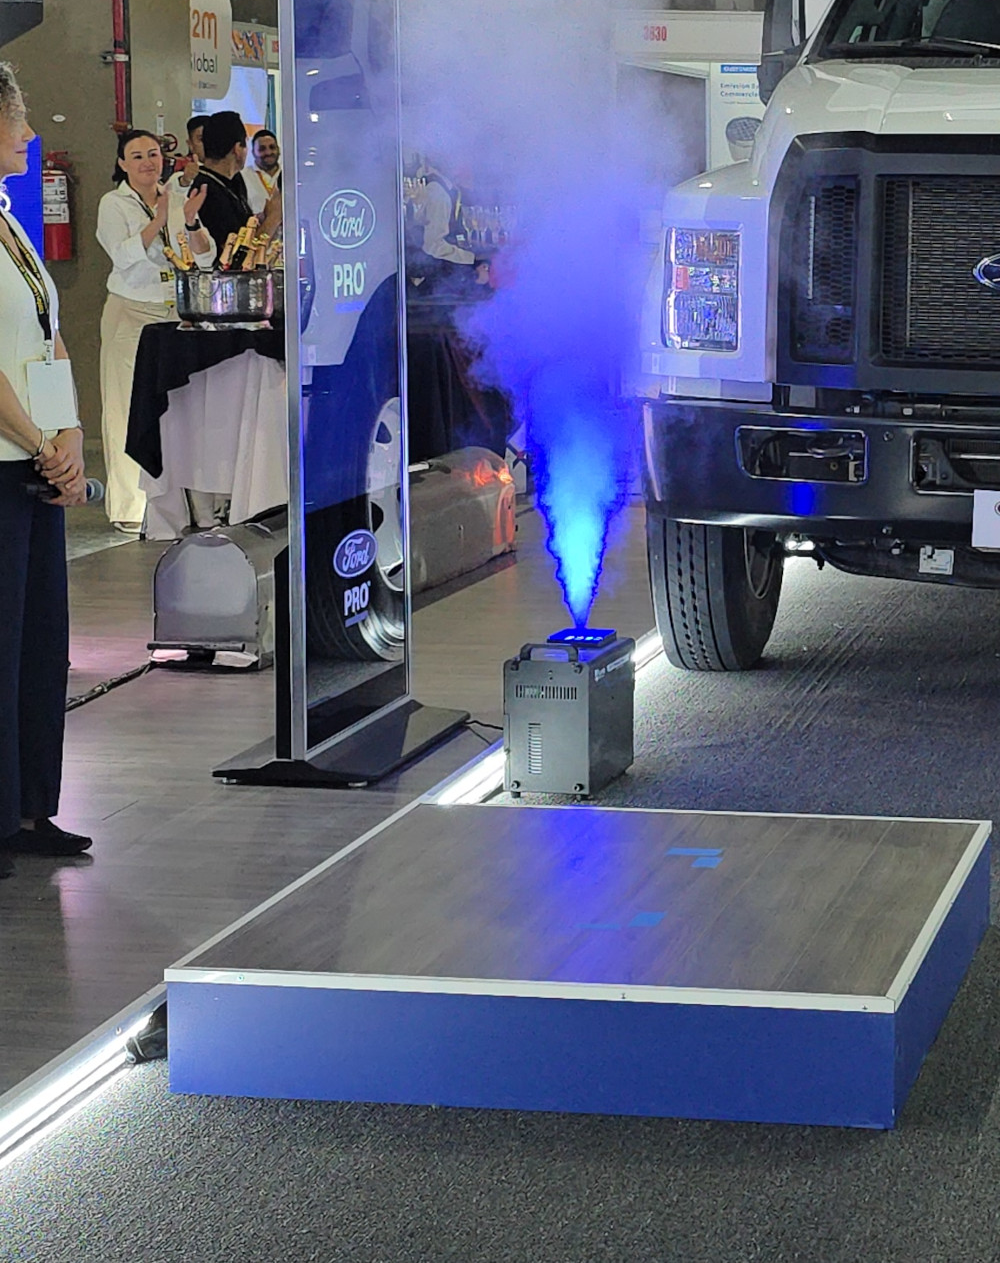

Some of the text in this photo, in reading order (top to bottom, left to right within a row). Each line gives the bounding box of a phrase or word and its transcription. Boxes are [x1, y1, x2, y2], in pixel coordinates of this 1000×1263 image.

[191, 52, 218, 74] lobal
[330, 197, 366, 238] Ford
[333, 261, 365, 298] PRO
[342, 537, 370, 572] Ford
[344, 582, 369, 617] PRO
